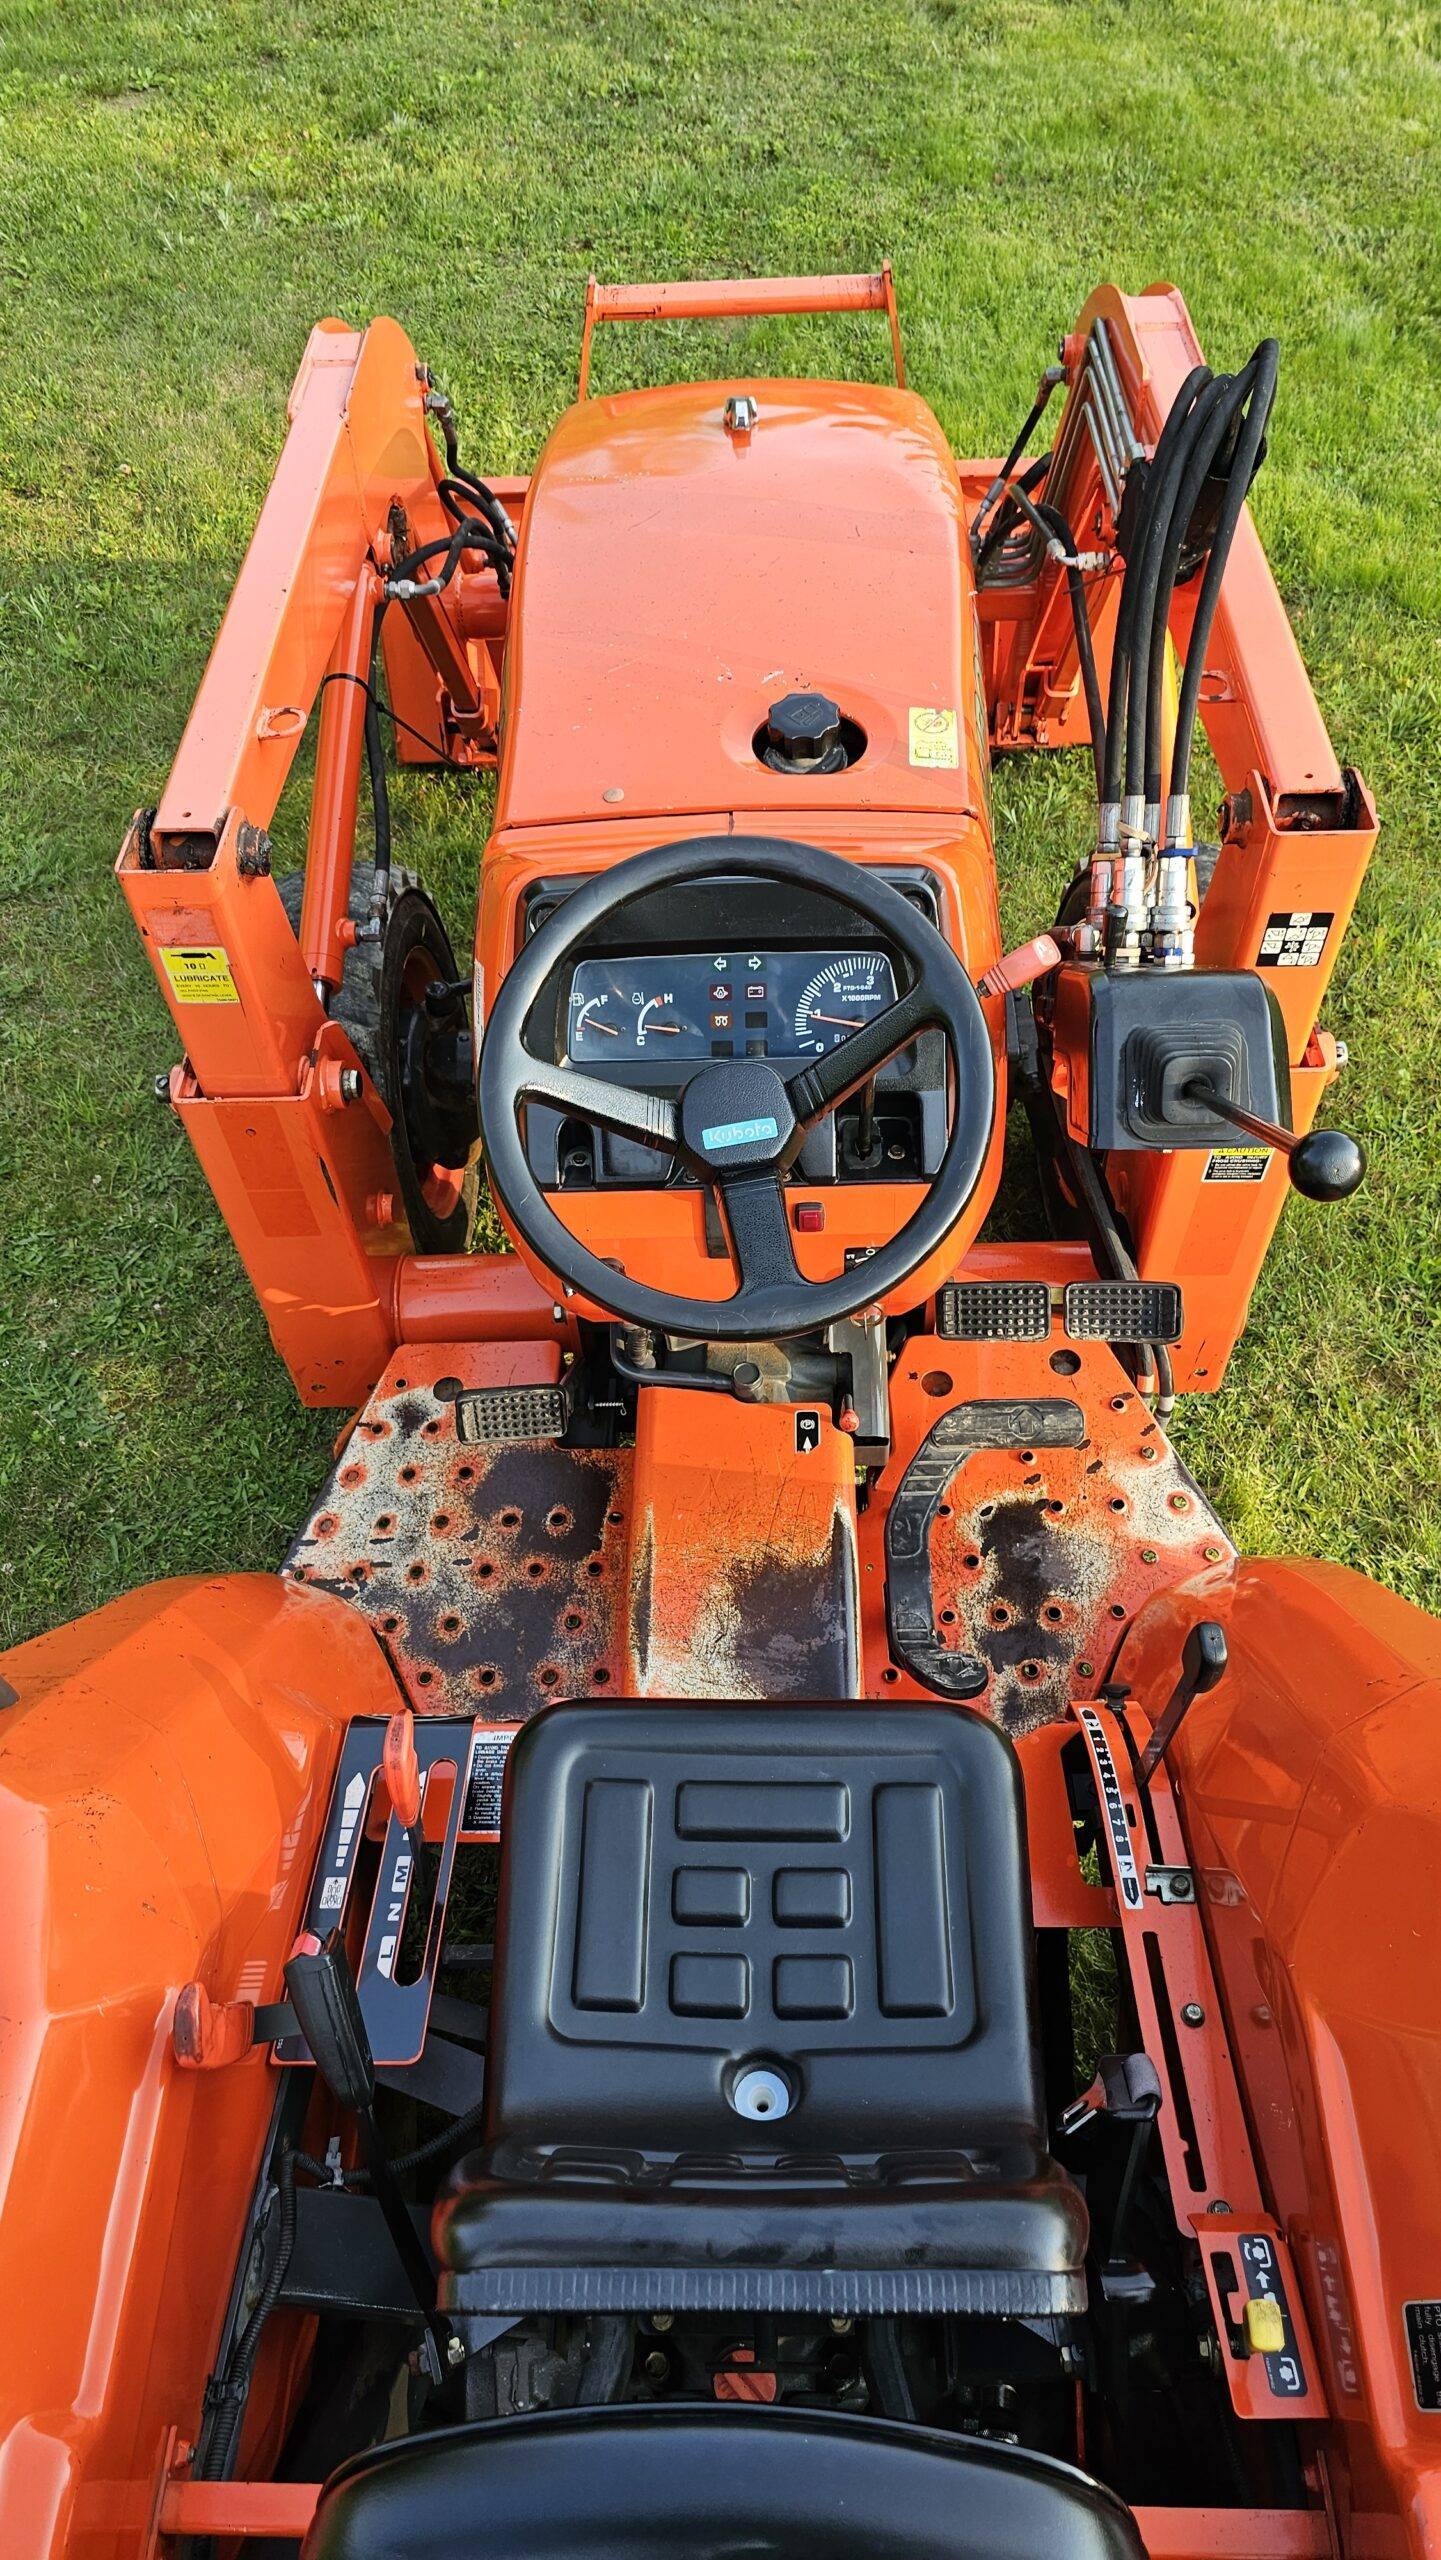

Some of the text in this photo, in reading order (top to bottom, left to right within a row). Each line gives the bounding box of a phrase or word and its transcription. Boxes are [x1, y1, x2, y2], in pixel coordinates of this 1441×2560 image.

[174, 974, 229, 982] LUBRICATE
[866, 976, 875, 986] 3
[834, 982, 842, 992] 2
[600, 993, 674, 1005] F H
[814, 1008, 821, 1016] 1
[576, 1032, 646, 1046] E C
[816, 1042, 824, 1052] 0
[708, 1122, 772, 1142] Kubota
[1108, 1802, 1118, 1810] 6
[1112, 1818, 1122, 1826] 7
[394, 1866, 408, 1882] M
[388, 1903, 401, 1921] N
[380, 1945, 394, 1958] L
[1414, 2306, 1423, 2329] main
[1424, 2306, 1432, 2326] fully
[1428, 2334, 1440, 2382] disengage
